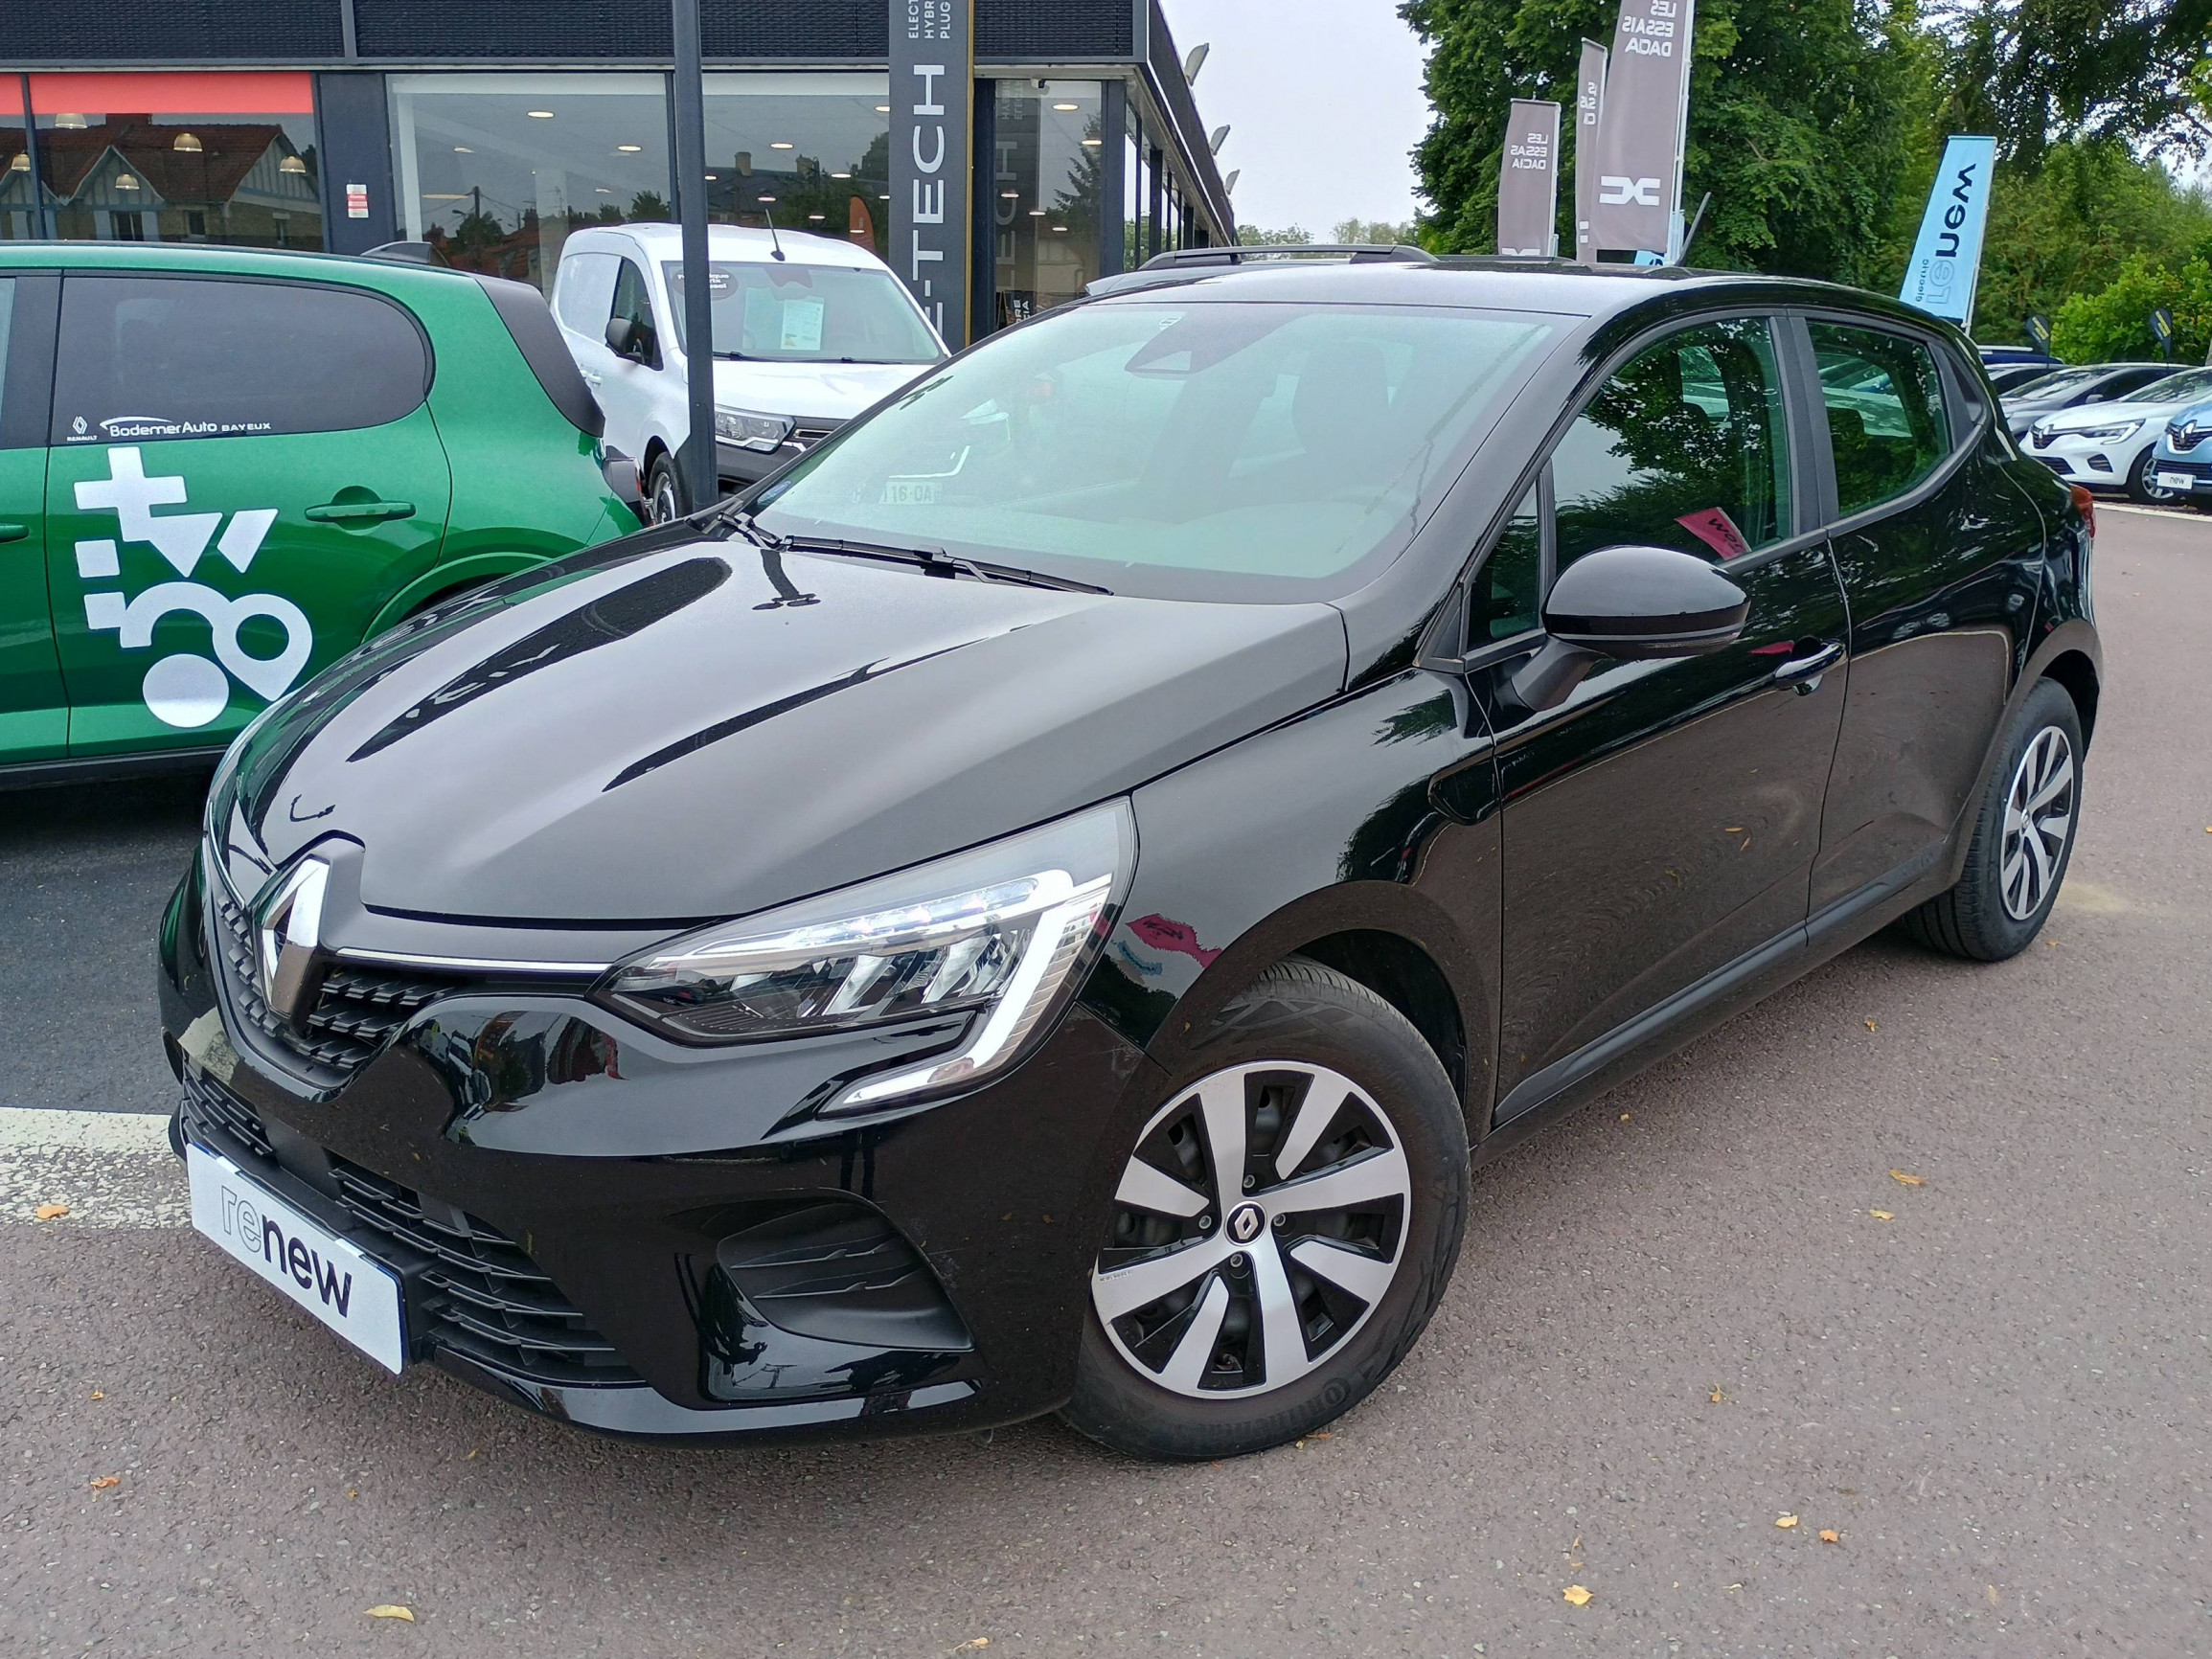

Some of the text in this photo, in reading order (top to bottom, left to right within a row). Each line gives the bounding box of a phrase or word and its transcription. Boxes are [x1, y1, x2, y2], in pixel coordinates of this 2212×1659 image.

[924, 0, 935, 38] HYBR
[940, 1, 950, 38] PLUG
[221, 422, 271, 432] BAYEUX
[221, 1184, 353, 1319] renew
